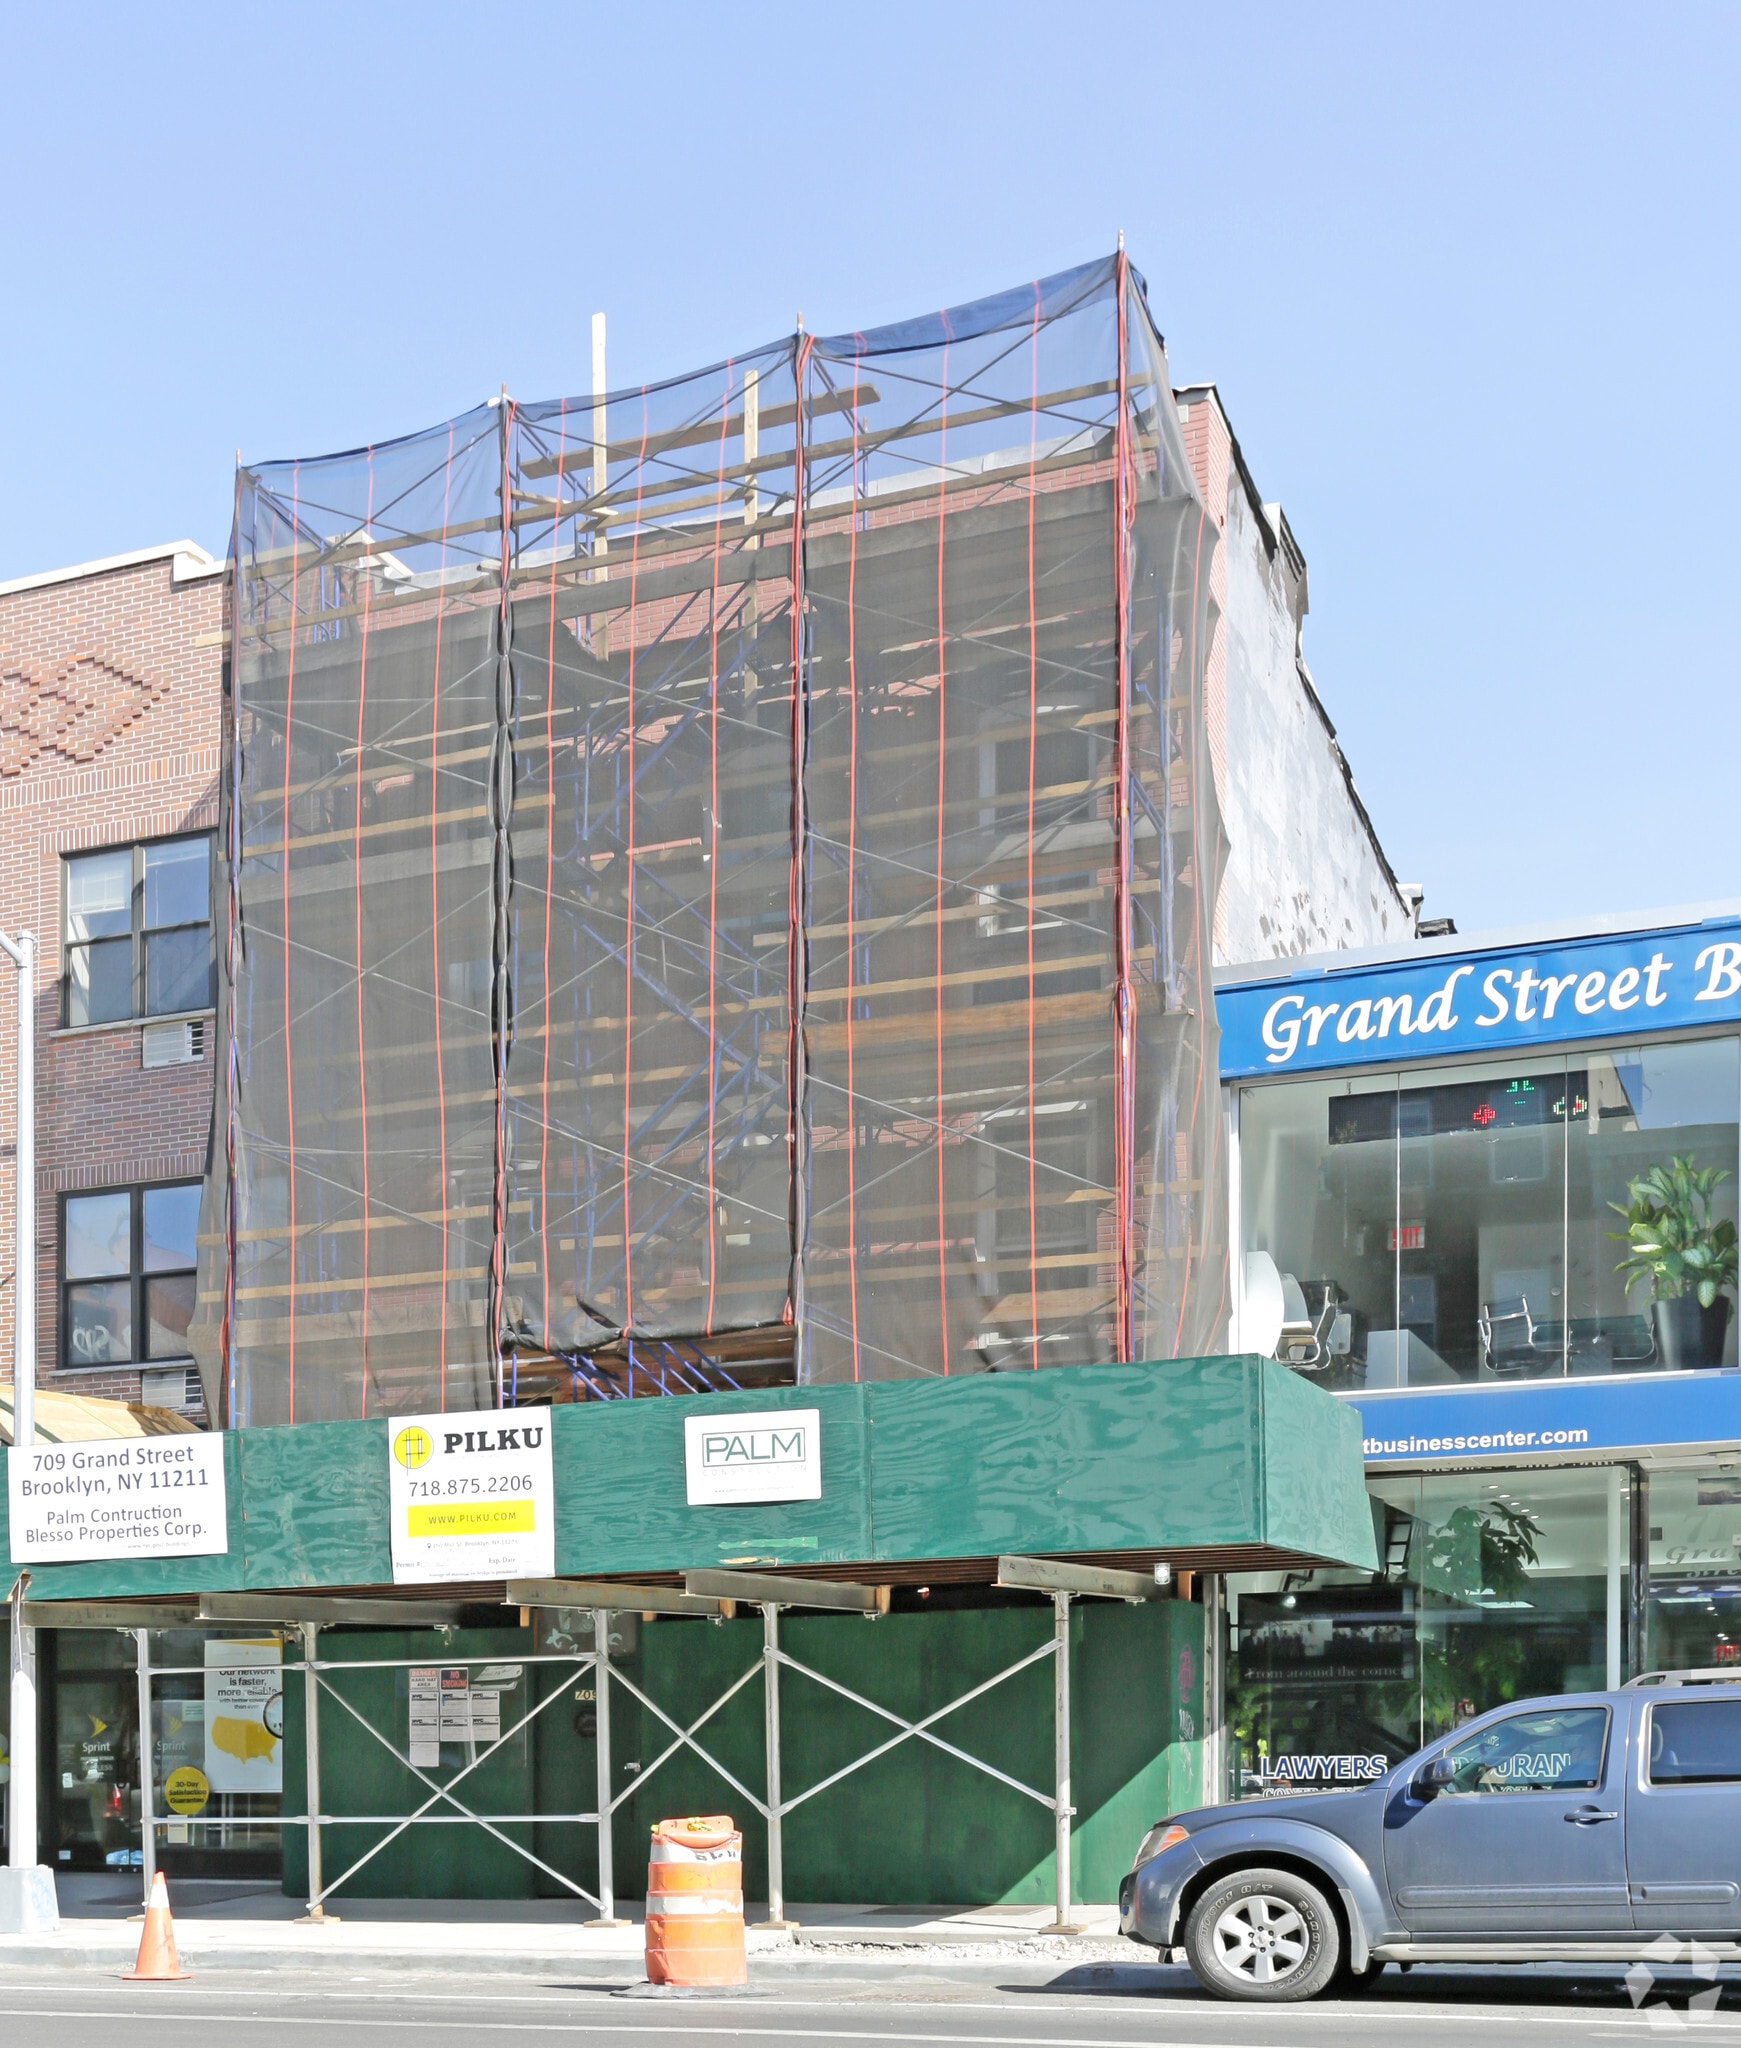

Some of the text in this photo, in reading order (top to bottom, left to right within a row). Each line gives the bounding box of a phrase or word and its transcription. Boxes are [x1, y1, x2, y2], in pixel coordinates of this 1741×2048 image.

[1261, 965, 1476, 1064] Grand
[1475, 952, 1674, 1027] Street
[444, 1427, 543, 1453] PILKU
[706, 1432, 802, 1462] PALM
[1363, 1429, 1588, 1455] tbusinesscenter.com
[33, 1446, 194, 1471] 709 Grand Street
[22, 1469, 208, 1496] Brooklyn, NY 11211
[409, 1475, 533, 1497] 718.875.2206
[47, 1505, 182, 1524] Palm Contruction
[428, 1512, 517, 1524] WWW.PILKU.COM
[26, 1522, 207, 1544] Blesso Properties Corp.
[229, 1677, 267, 1686] is faster,
[450, 1670, 460, 1679] NO
[1287, 1666, 1334, 1678] around
[1338, 1665, 1357, 1676] the
[82, 1742, 111, 1754] Sprint
[156, 1741, 186, 1752] Sprint
[1261, 1754, 1388, 1779] LAWYERS
